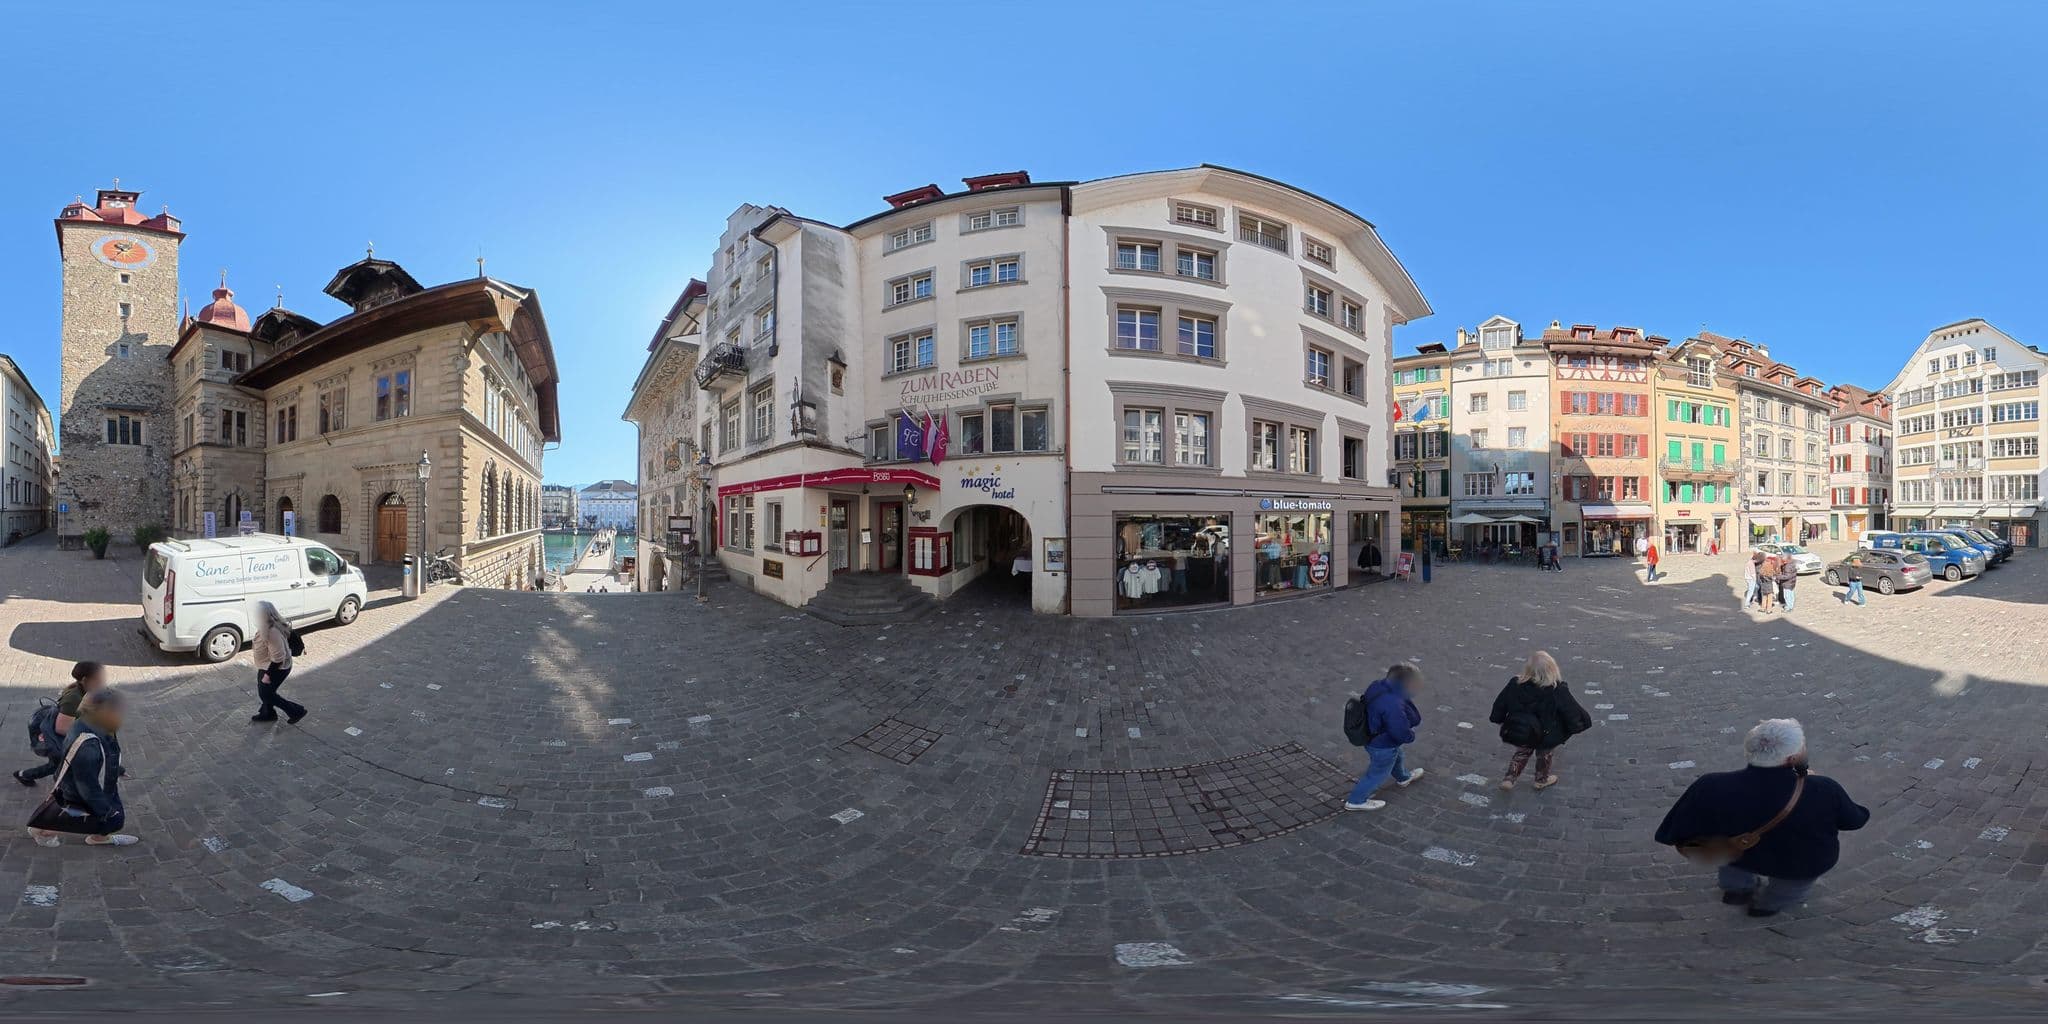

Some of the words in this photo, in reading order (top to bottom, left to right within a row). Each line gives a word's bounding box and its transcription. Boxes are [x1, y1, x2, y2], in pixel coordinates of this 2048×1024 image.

[901, 376, 937, 395] ZUM
[941, 366, 1000, 390] RABEN
[901, 381, 999, 404] SCHULTHEISSENSTUBE
[961, 472, 1001, 492] magic
[992, 487, 1015, 499] hotel
[1273, 499, 1332, 510] blue-tomato
[195, 559, 230, 578] Sane
[247, 556, 276, 573] Team
